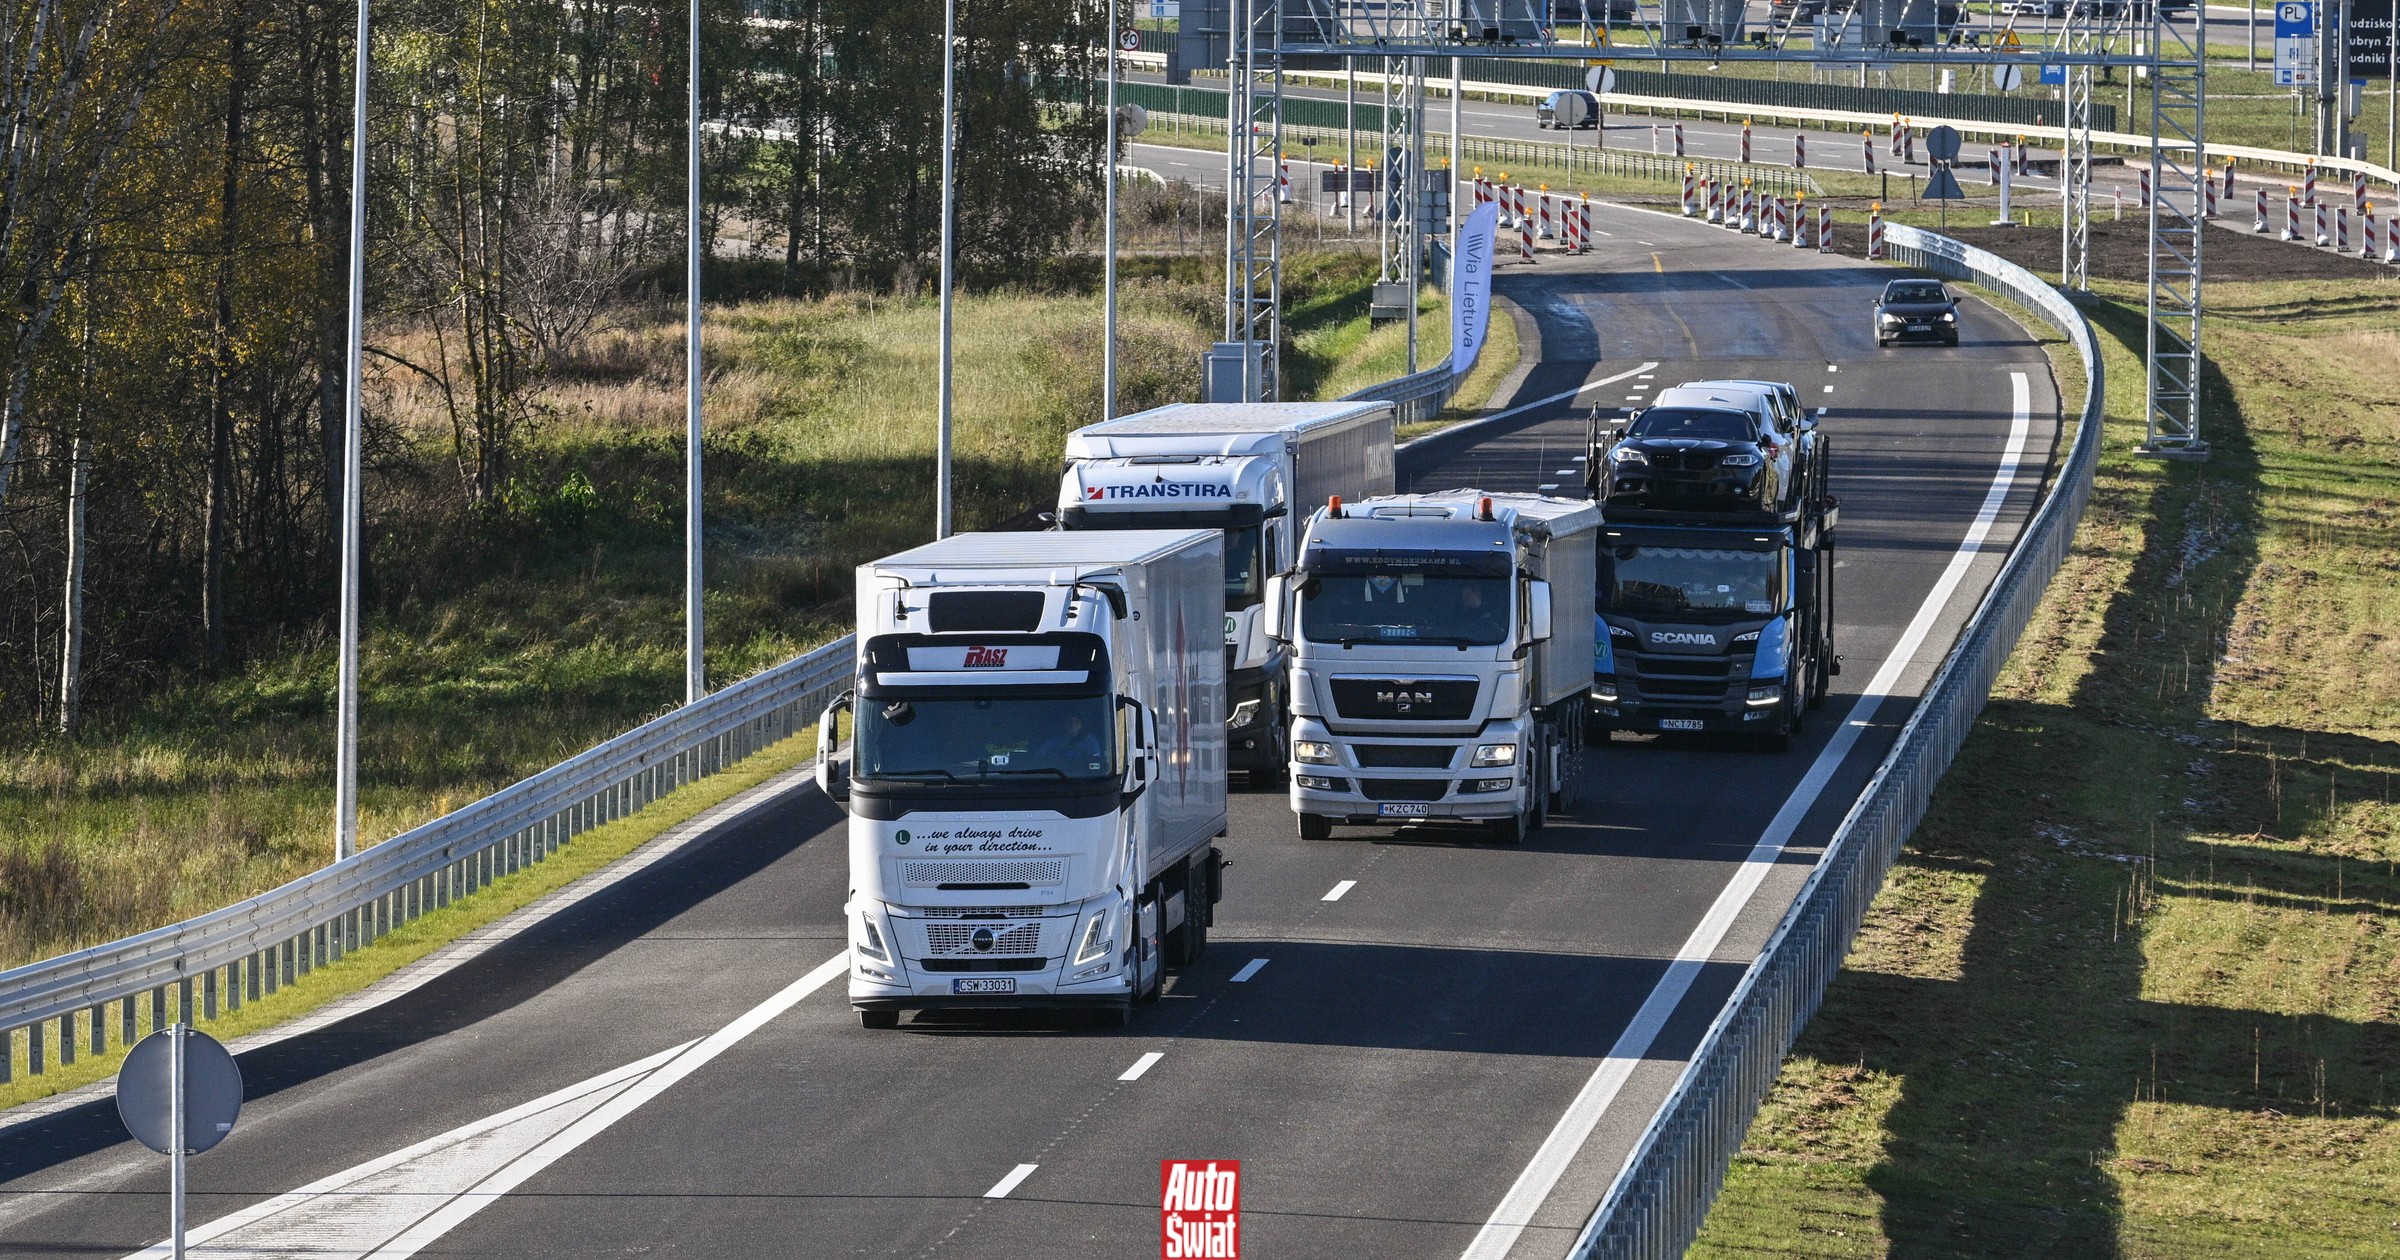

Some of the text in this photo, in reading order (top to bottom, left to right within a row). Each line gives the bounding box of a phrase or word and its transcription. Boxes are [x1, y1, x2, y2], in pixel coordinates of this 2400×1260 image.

[2284, 6, 2301, 20] PL
[2350, 18, 2393, 28] udzisko
[1122, 33, 1137, 46] 90
[2349, 35, 2381, 48] ubryn
[2350, 52, 2385, 63] udniki
[1463, 246, 1482, 348] Via Lietuva
[1106, 484, 1232, 499] TRANSTIRA
[1651, 632, 1717, 645] SCANIA
[964, 646, 1008, 664] RASZ
[1377, 691, 1432, 703] MAN
[1668, 720, 1703, 729] NCT785
[1389, 805, 1427, 814] KZC740
[954, 827, 1002, 842] always
[1008, 827, 1043, 838] drive
[925, 842, 938, 852] in
[944, 843, 973, 855] your
[960, 980, 1012, 991] CSW 33031
